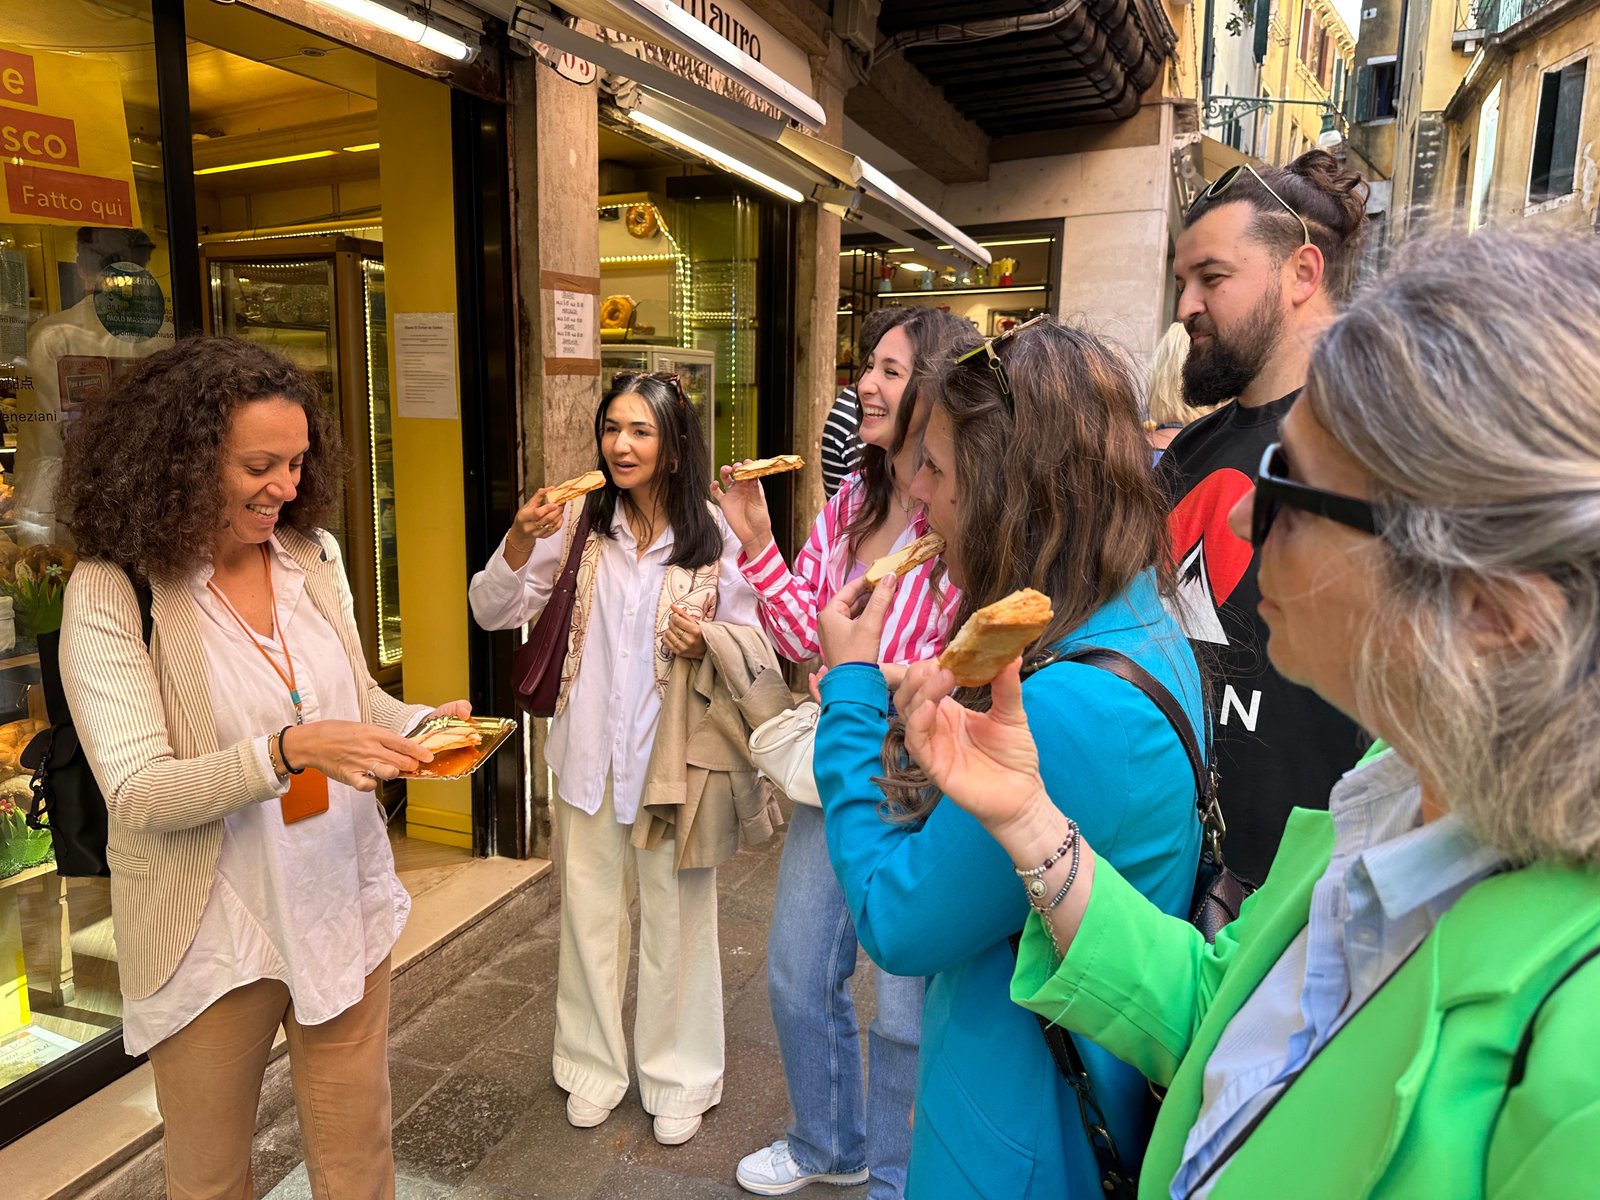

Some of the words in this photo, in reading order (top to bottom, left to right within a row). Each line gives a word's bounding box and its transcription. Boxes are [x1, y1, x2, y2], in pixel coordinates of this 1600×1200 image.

[2, 68, 25, 95] e
[2, 126, 68, 159] sco
[22, 185, 83, 212] Fatto
[91, 199, 123, 220] qui
